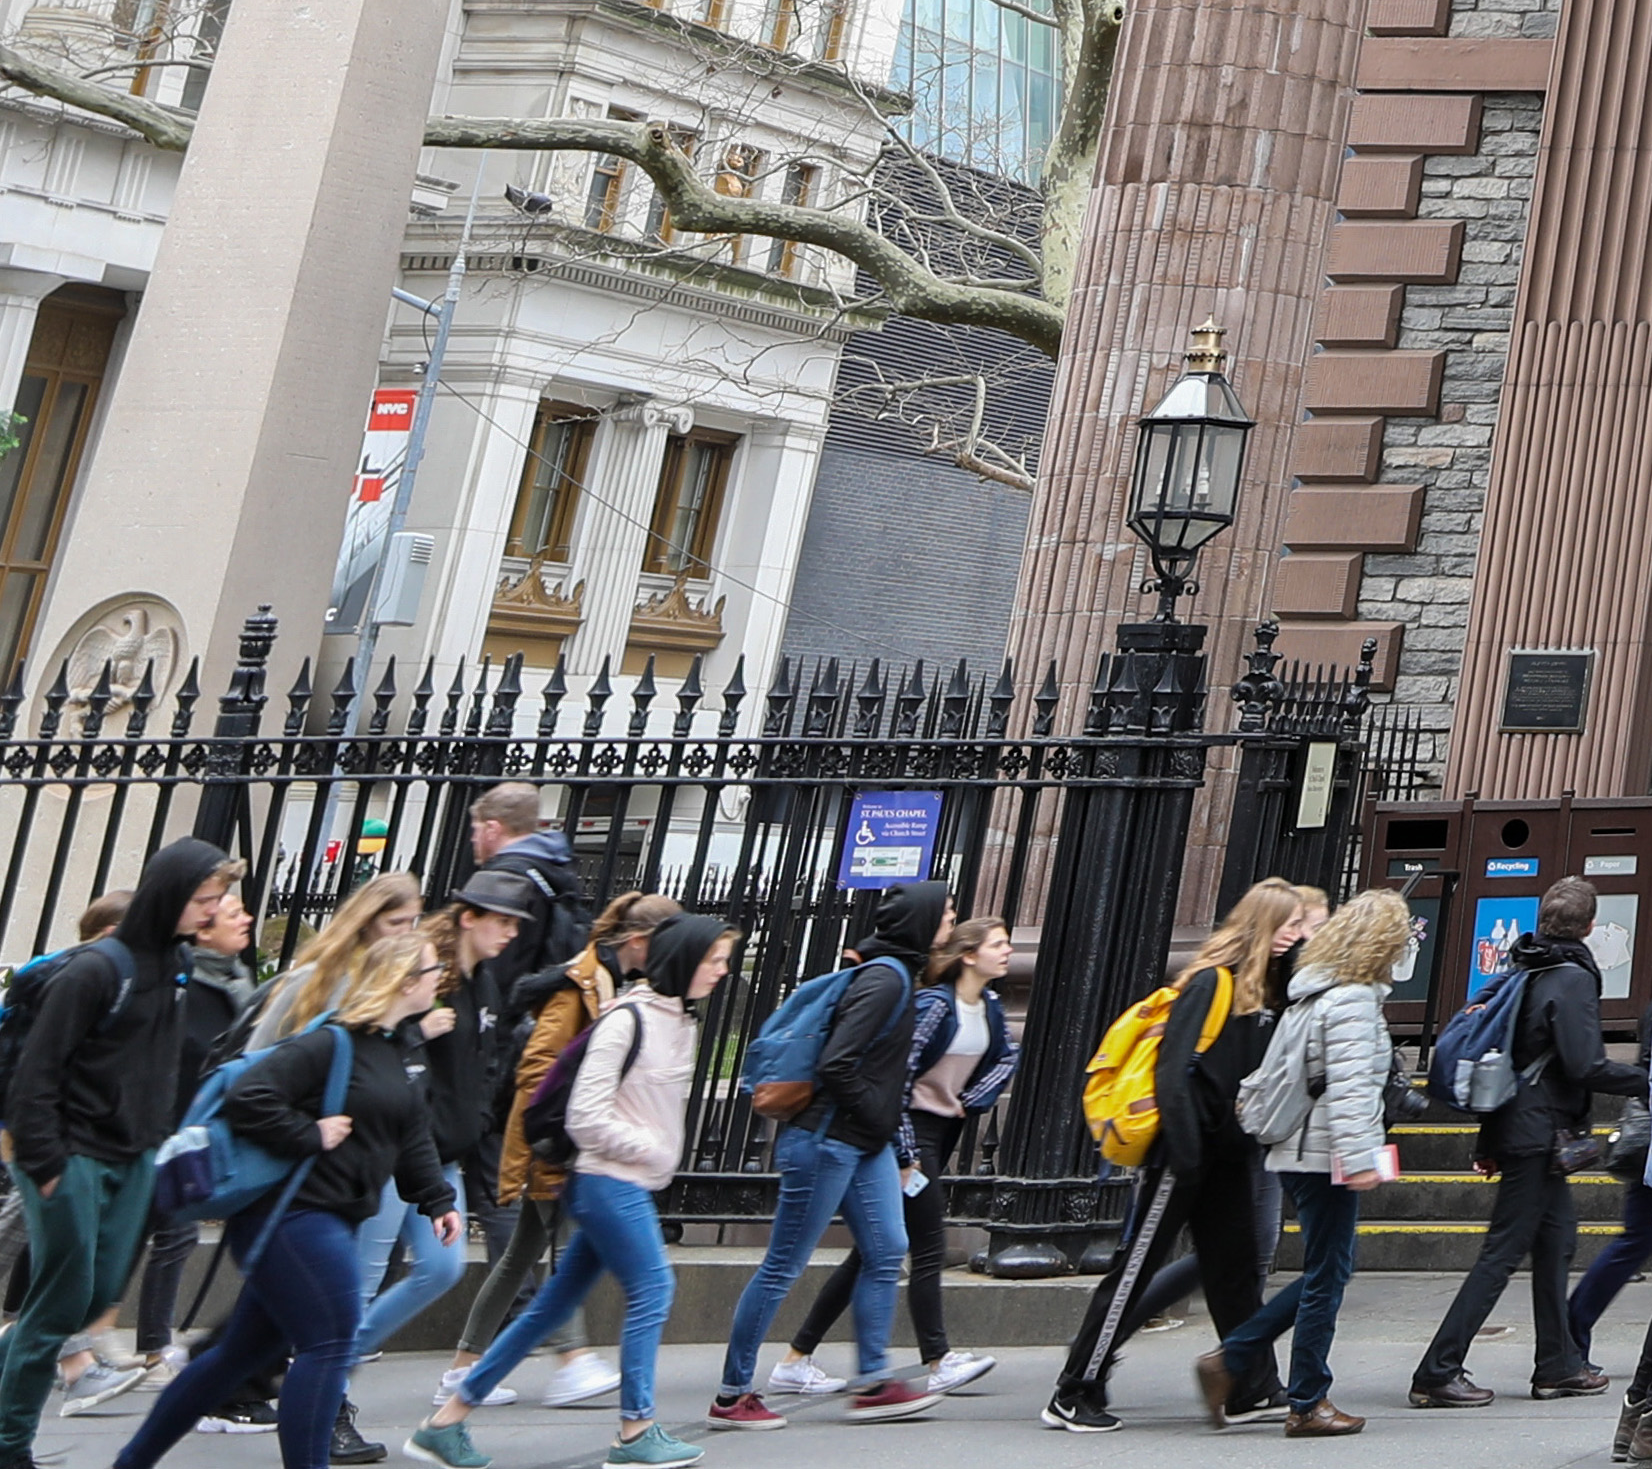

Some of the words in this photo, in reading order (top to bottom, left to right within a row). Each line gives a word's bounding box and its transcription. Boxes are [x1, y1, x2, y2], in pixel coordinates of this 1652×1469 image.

[377, 403, 408, 415] NYC
[896, 810, 927, 818] CHAPEL
[1497, 862, 1529, 871] Recycling
[1125, 1240, 1149, 1276] ROCKS
[1103, 1280, 1132, 1331] MISTRESS
[1091, 1331, 1112, 1368] ROCKS
